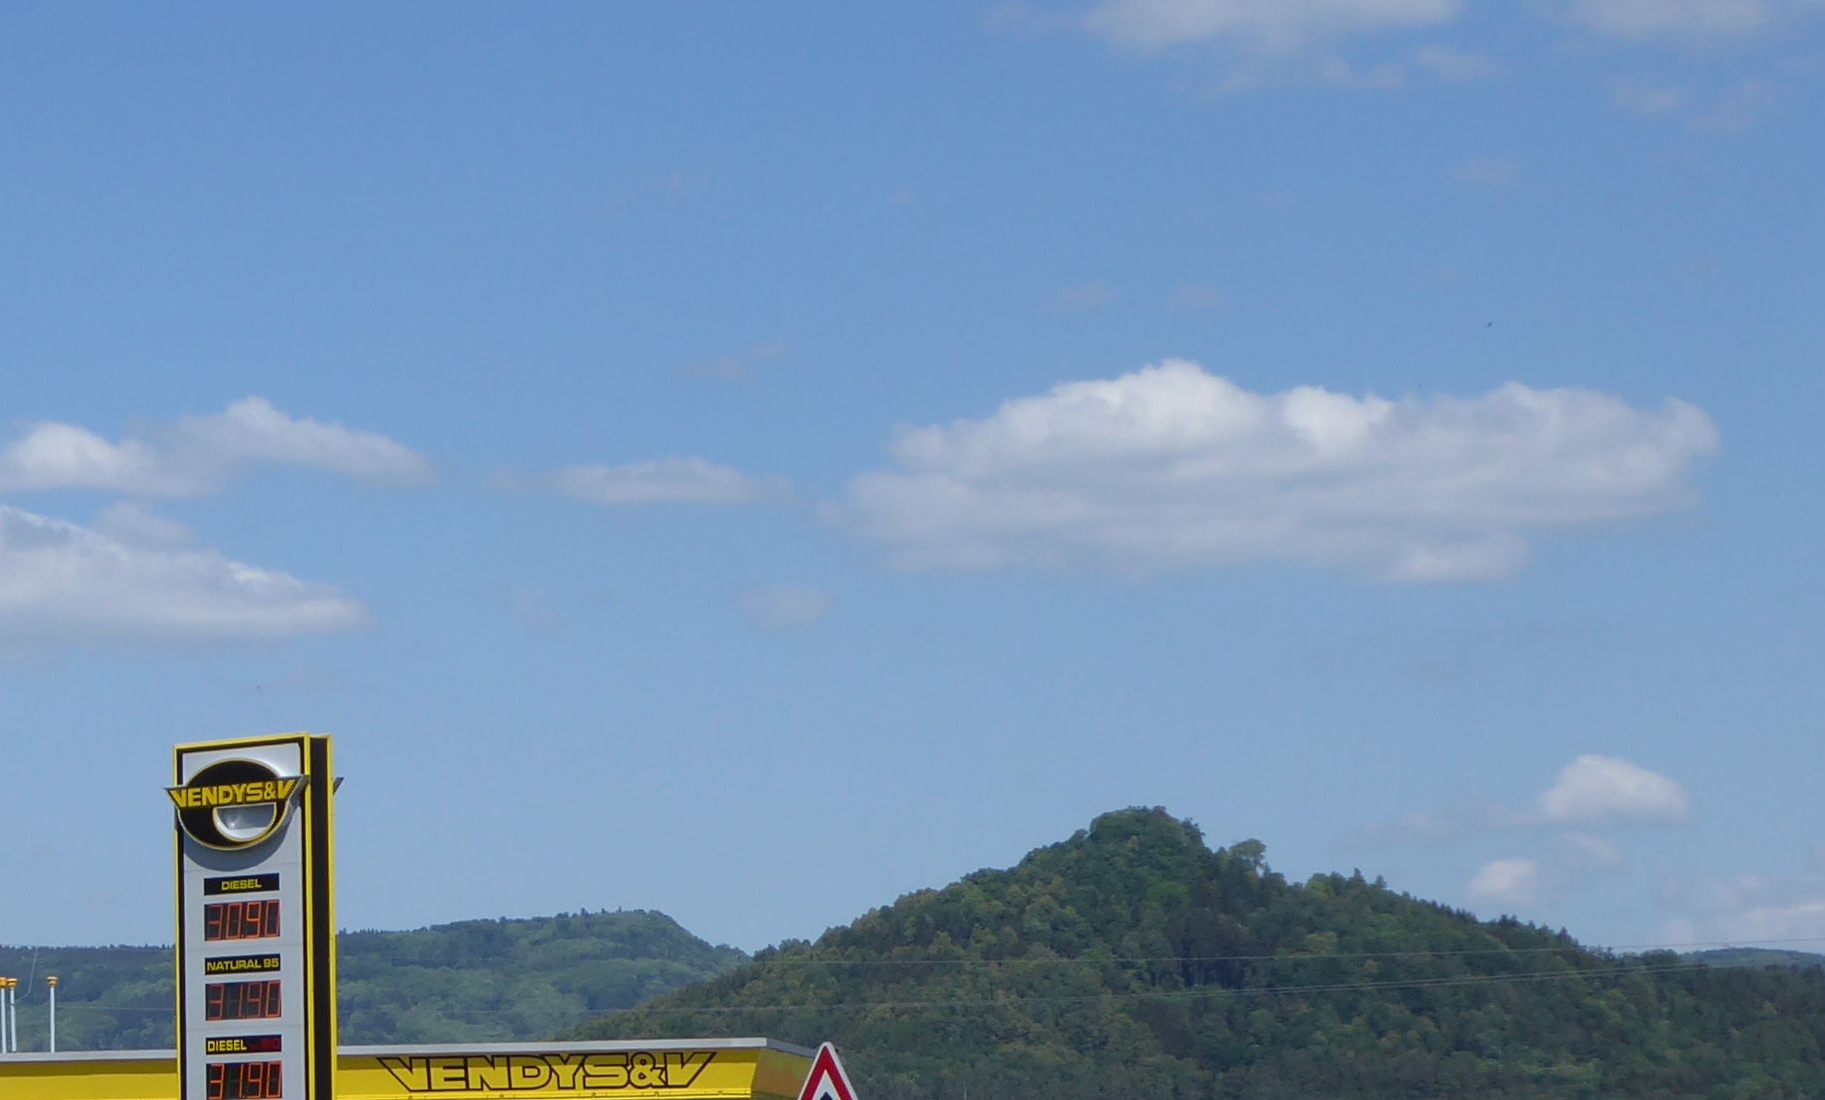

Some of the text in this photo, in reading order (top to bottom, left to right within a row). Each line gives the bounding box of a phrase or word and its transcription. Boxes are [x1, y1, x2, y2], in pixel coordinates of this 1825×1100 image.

[168, 779, 296, 808] VENDYS&V
[221, 878, 262, 891] DIESEL
[206, 958, 279, 971] NATURAL 95
[207, 1039, 247, 1051] DIESEL
[377, 1052, 717, 1092] VENDYS&V
